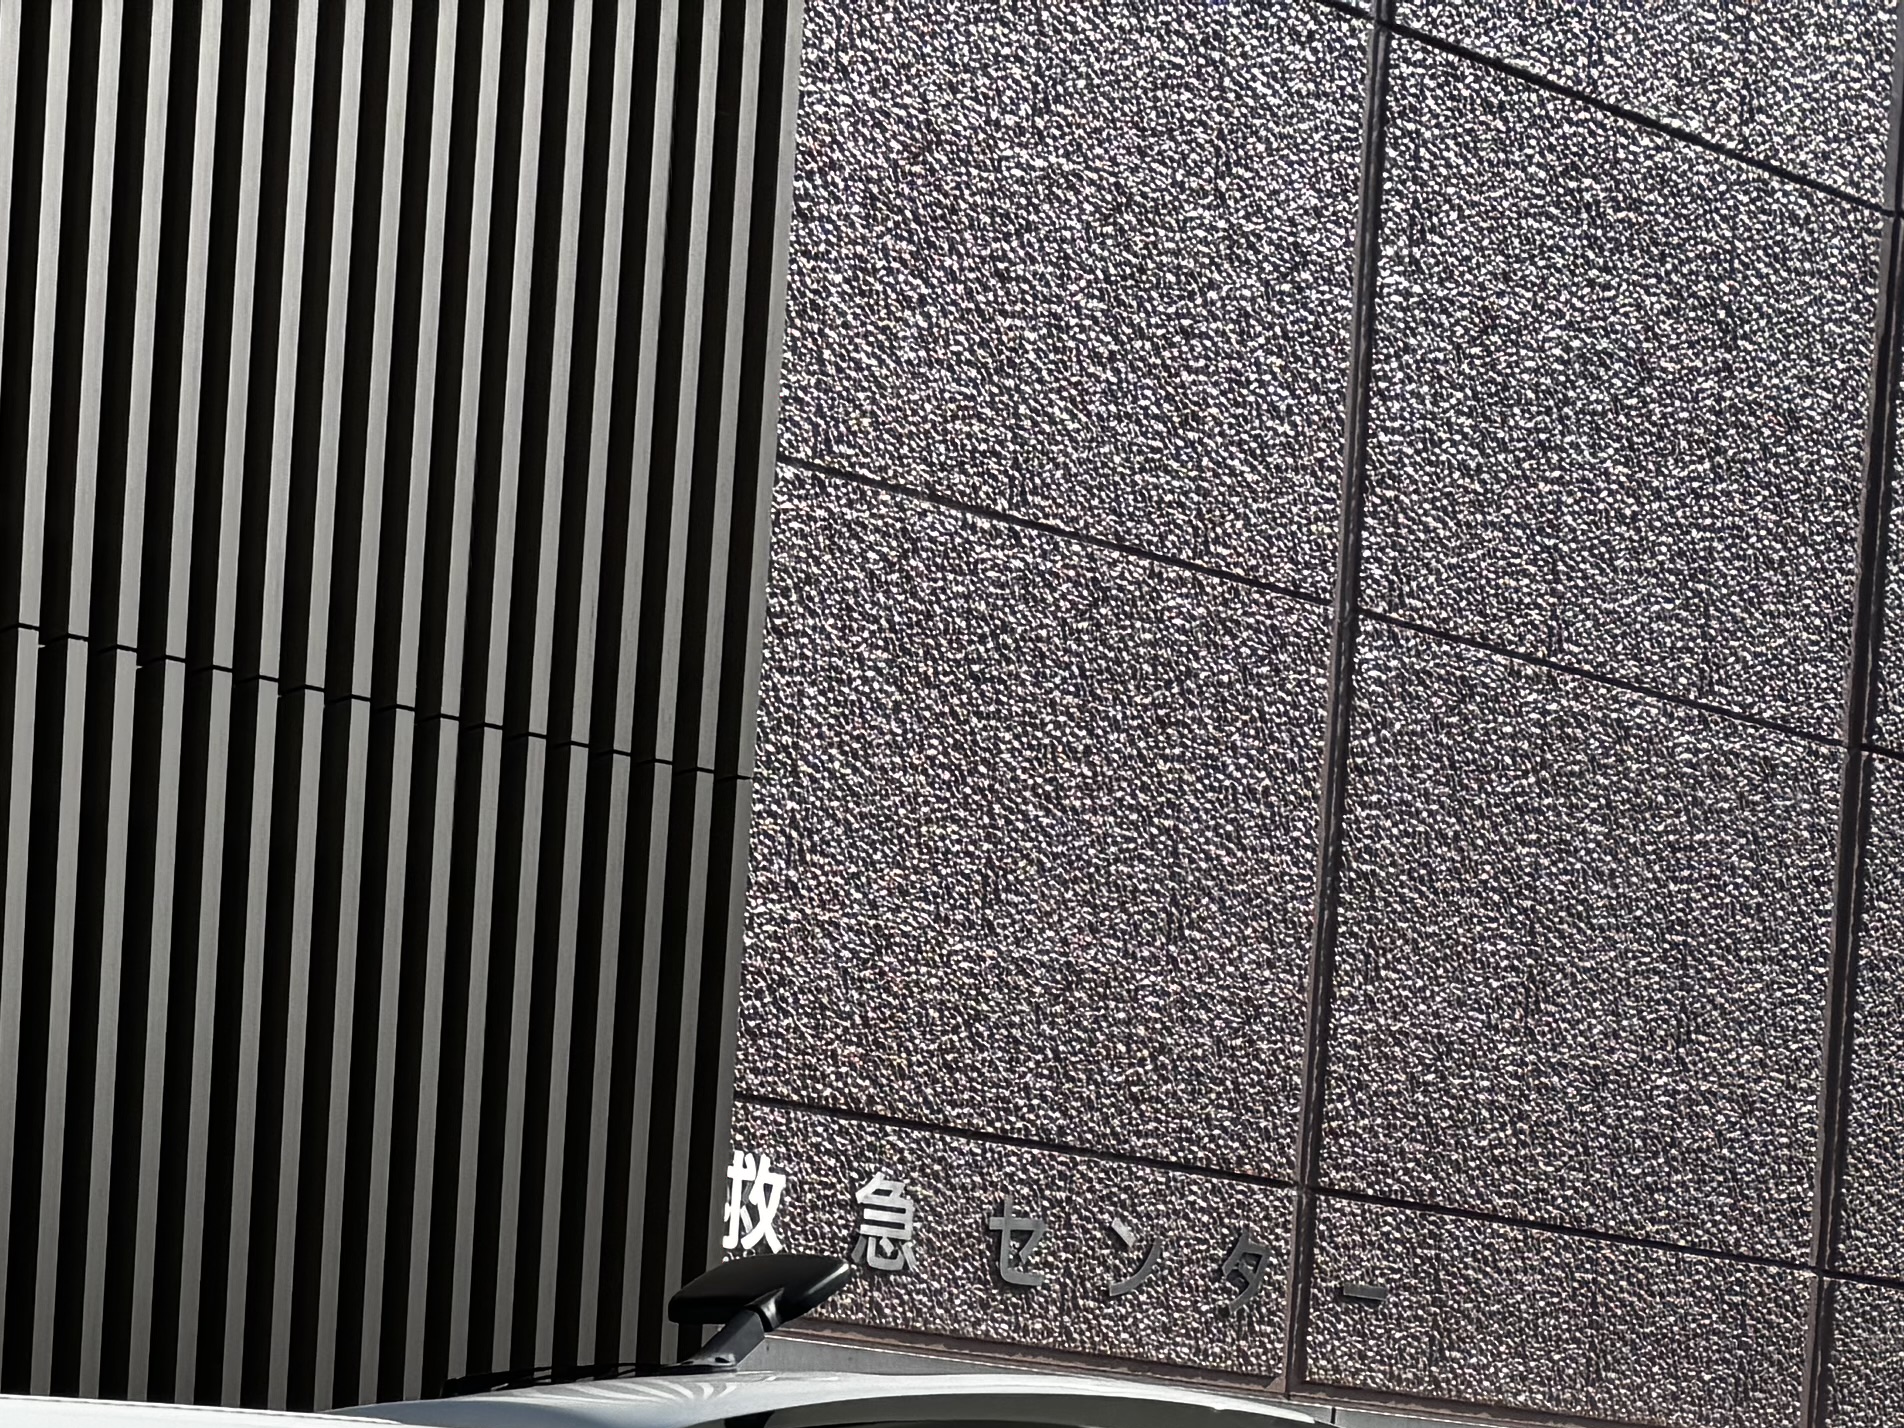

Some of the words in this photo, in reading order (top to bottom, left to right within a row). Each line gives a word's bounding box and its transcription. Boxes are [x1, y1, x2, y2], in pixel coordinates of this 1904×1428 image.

[722, 1148, 1389, 1312] 救急センター
